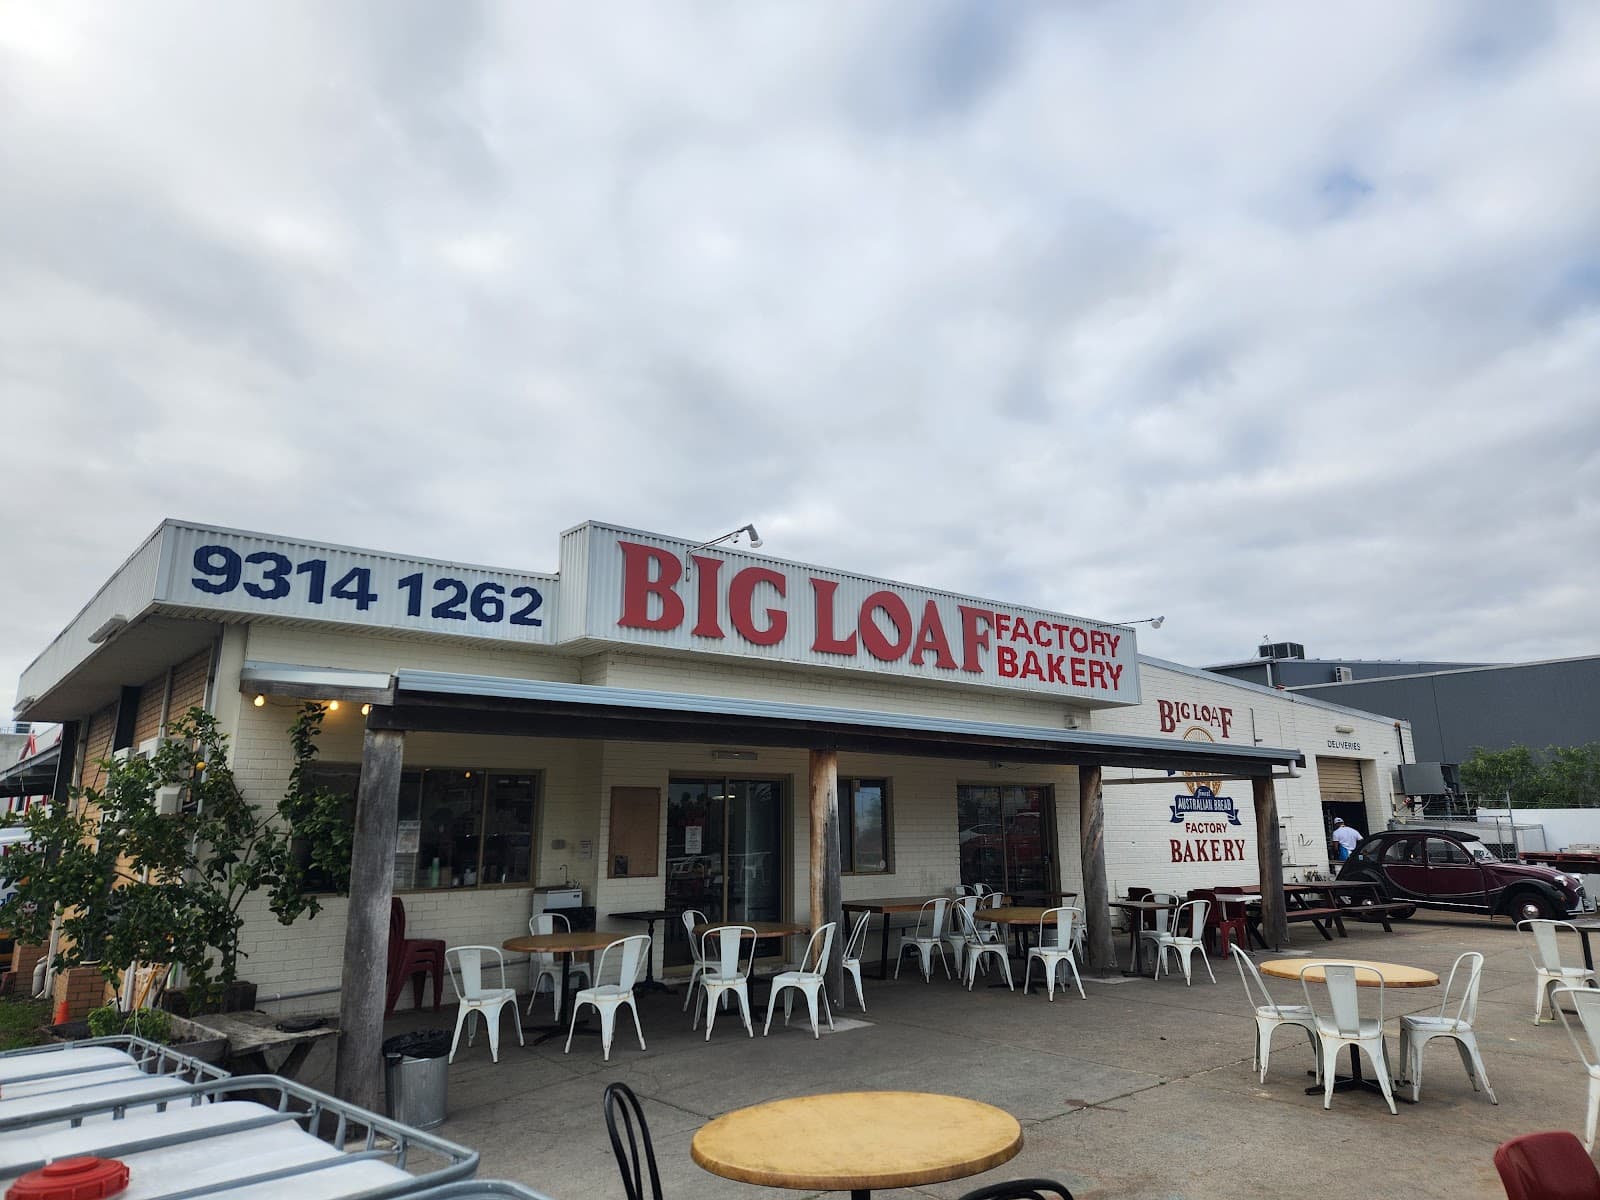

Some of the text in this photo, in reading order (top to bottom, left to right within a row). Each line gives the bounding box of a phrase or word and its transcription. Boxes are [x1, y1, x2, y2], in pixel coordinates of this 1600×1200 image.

[192, 545, 543, 627] 9314 1262
[617, 541, 995, 673] BIG LOAF
[995, 613, 1121, 658] FACTORY
[997, 646, 1123, 690] BAKERY
[1157, 699, 1232, 738] BIG LOAF
[1327, 740, 1361, 751] DELIVERIES
[1177, 797, 1232, 811] AUSTRALIAN BREAD
[1185, 822, 1228, 834] FACTORY
[1169, 839, 1245, 863] BAKERY
